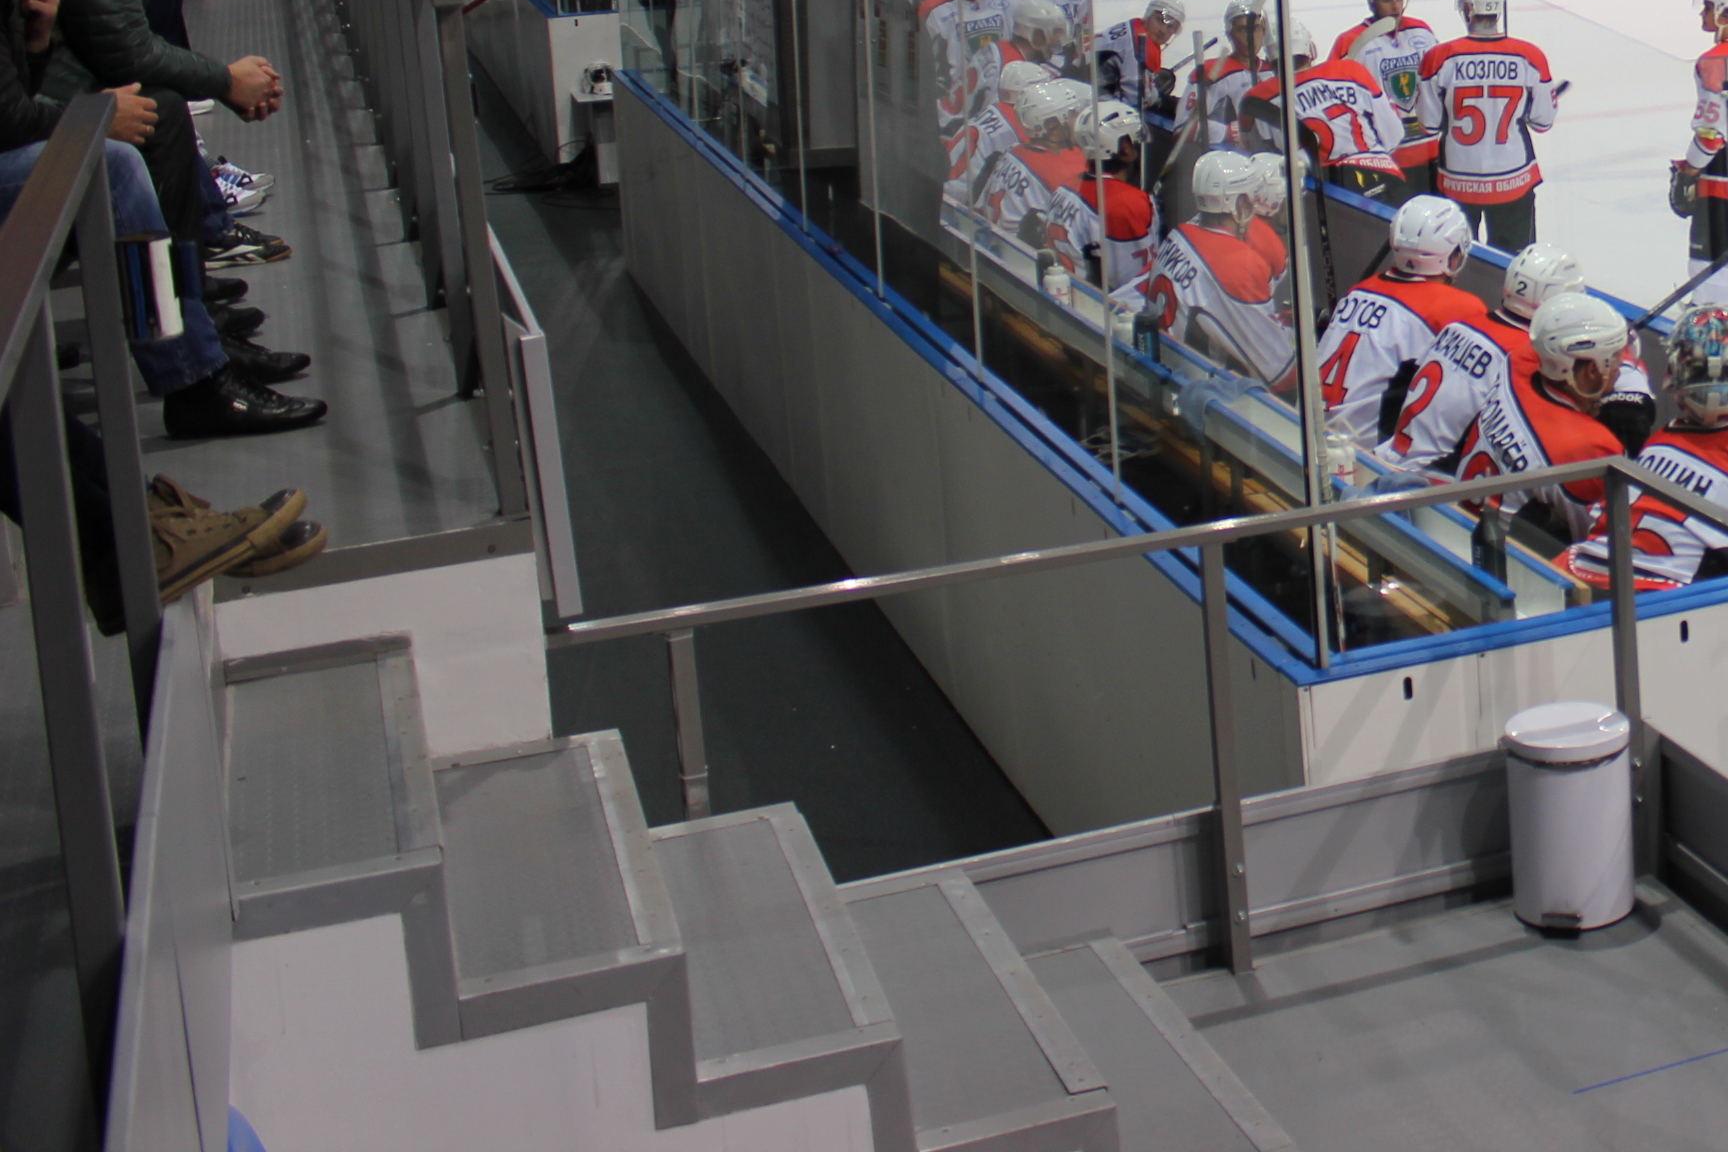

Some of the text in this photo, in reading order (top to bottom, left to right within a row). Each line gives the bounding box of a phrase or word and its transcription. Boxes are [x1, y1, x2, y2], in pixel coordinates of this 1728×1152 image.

[1455, 60, 1518, 80] КОЗЛОВ
[1451, 85, 1524, 146] 57
[1443, 173, 1531, 193] ИРКУТСКАЯ ОБЛАСТЬ
[1515, 280, 1528, 296] 2
[1391, 360, 1444, 456] 2
